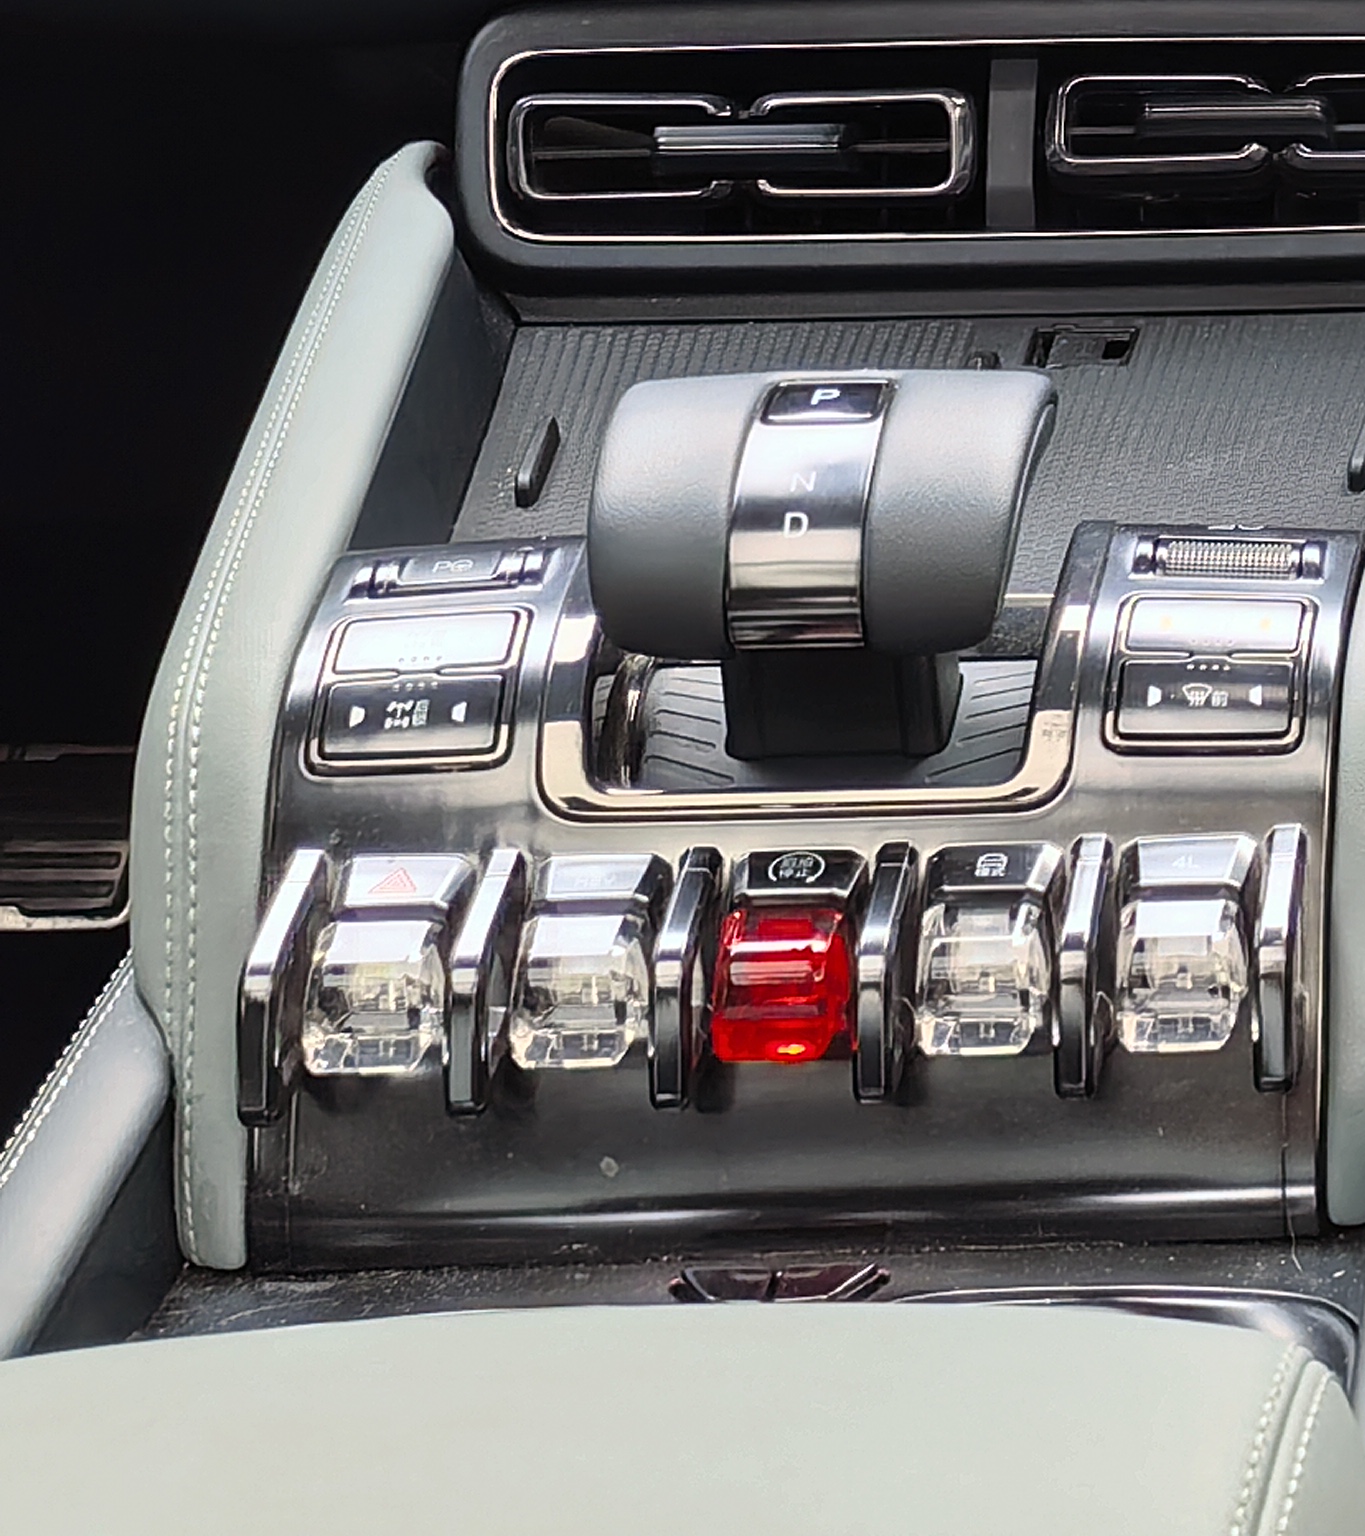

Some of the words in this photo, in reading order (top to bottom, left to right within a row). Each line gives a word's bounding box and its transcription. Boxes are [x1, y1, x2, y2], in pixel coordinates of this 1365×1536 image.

[810, 388, 841, 405] P
[789, 471, 818, 492] N
[783, 512, 809, 539] D
